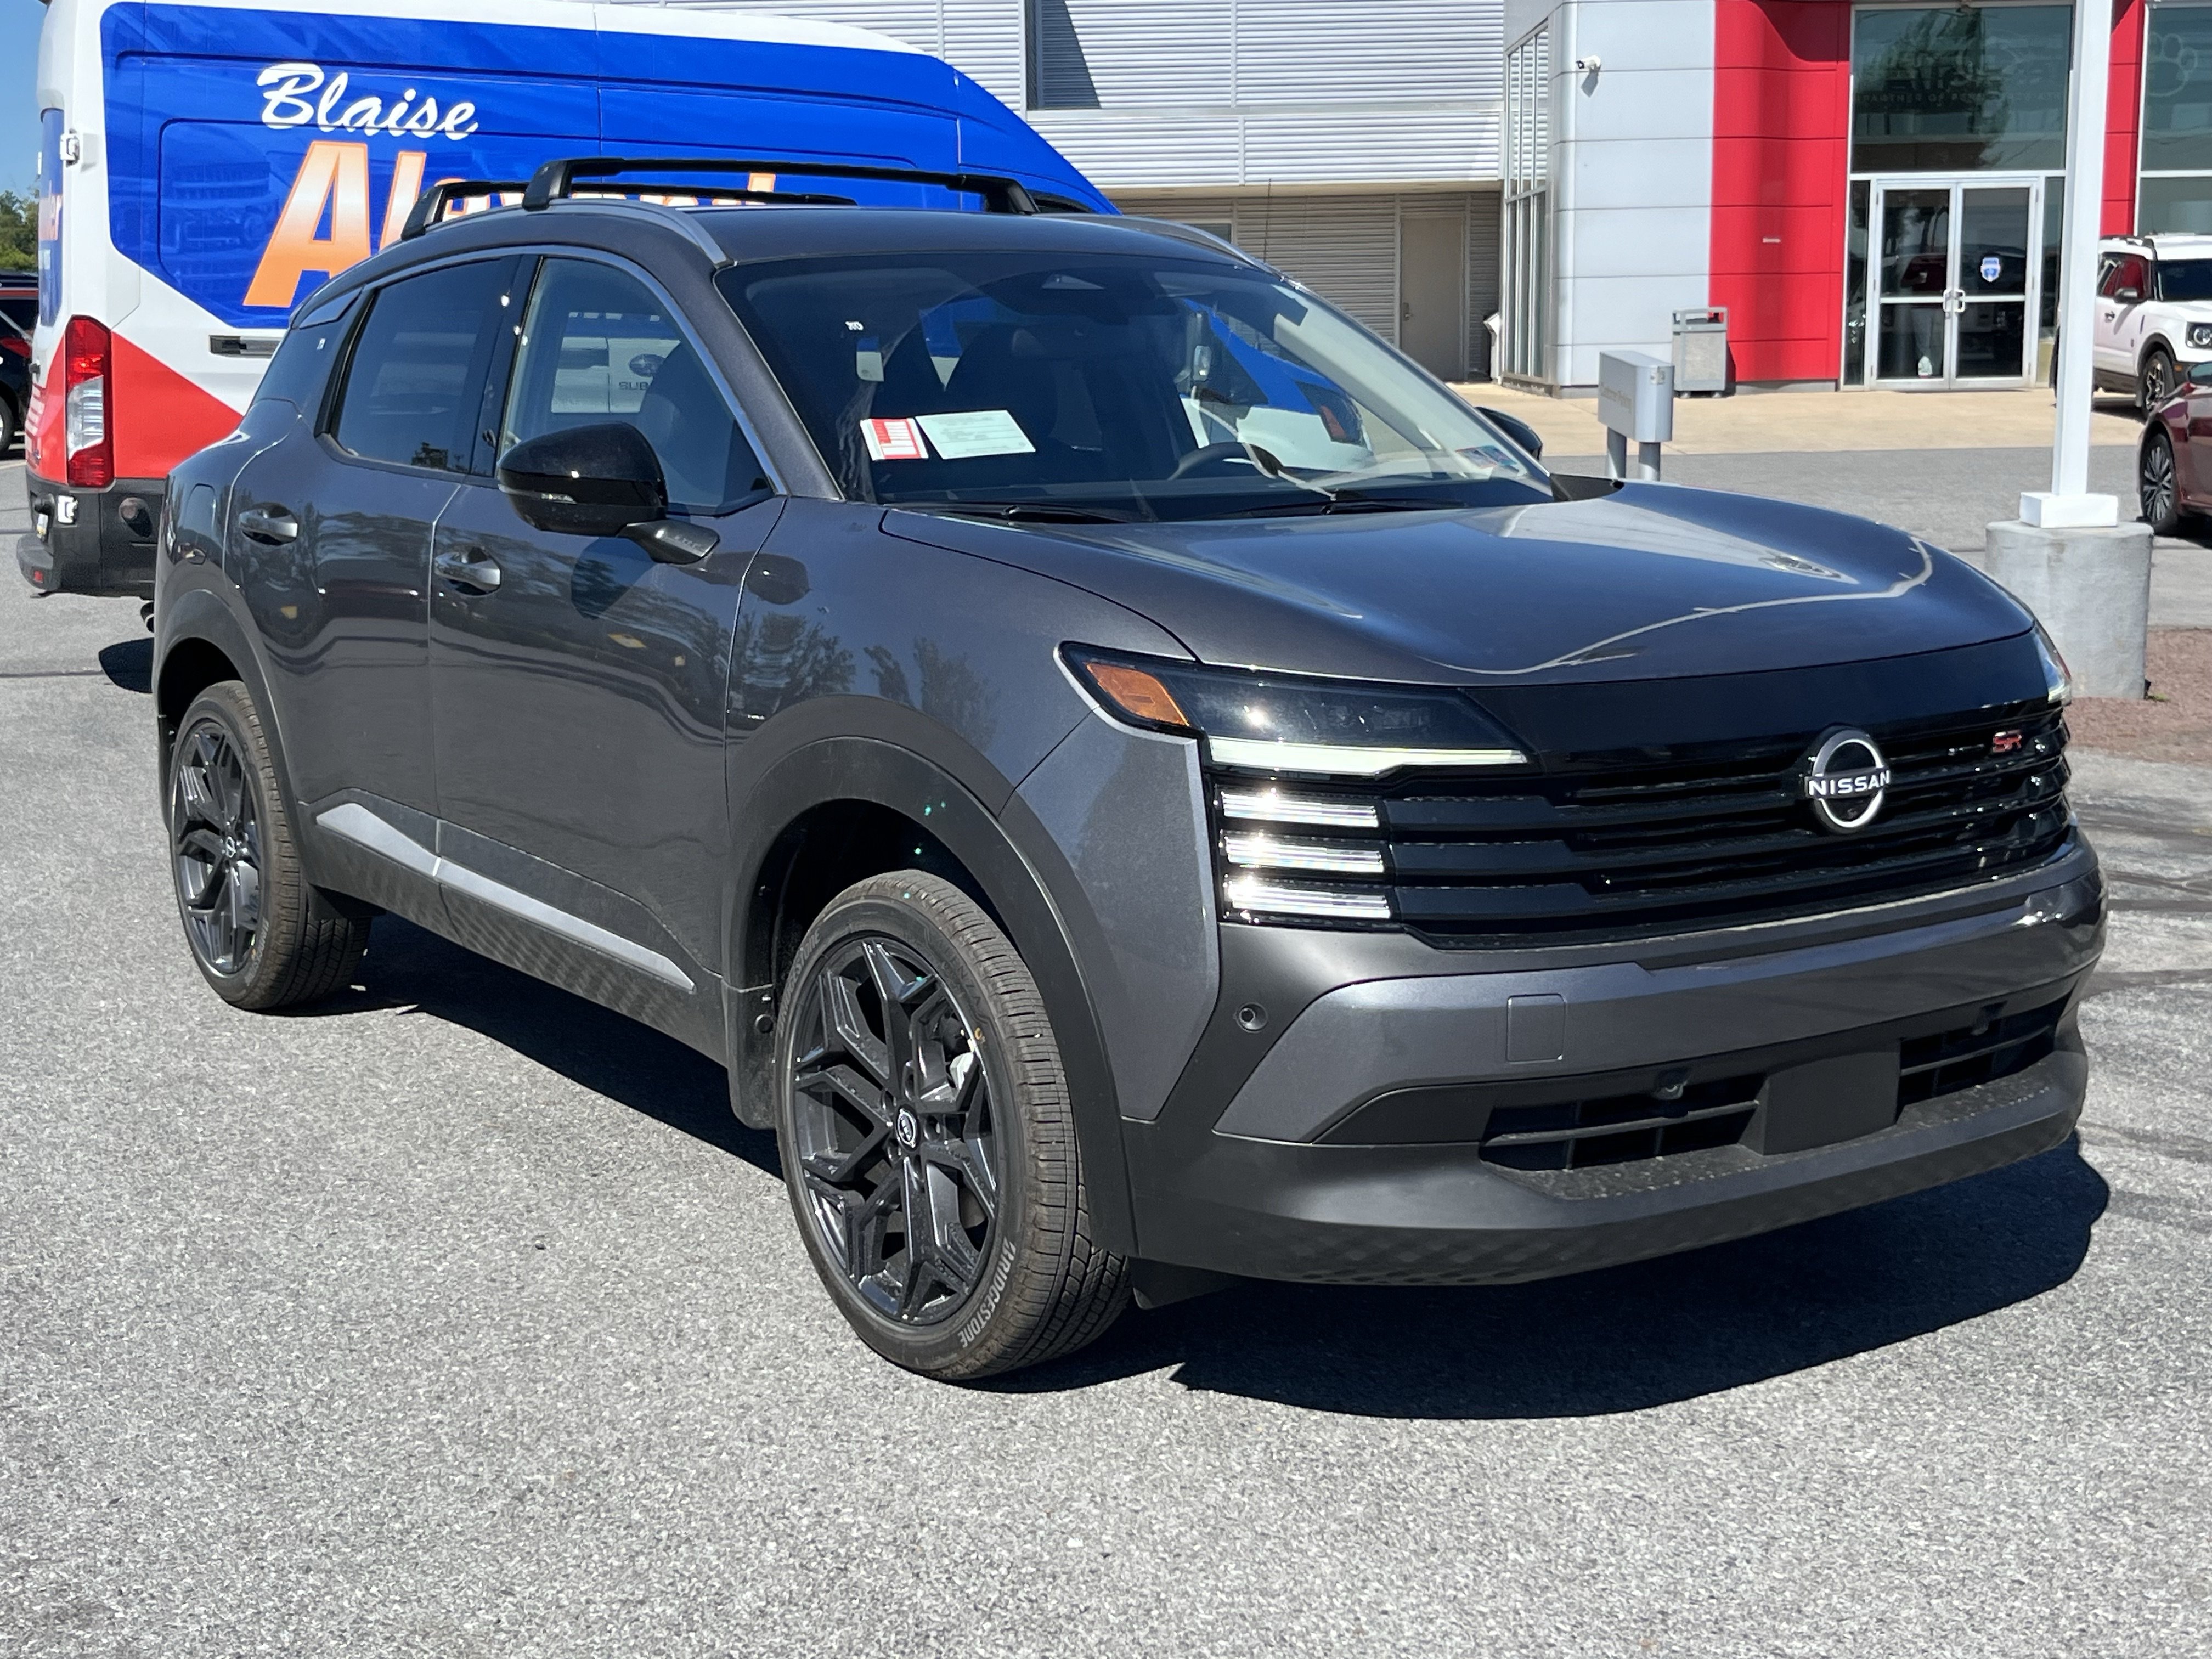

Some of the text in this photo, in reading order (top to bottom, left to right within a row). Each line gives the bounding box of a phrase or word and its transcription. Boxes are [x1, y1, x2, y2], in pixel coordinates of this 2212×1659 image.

[257, 63, 479, 140] Blaise
[619, 382, 649, 390] SUB
[1993, 730, 2023, 753] SR
[1809, 770, 1891, 796] NISSAN
[957, 1235, 1016, 1348] BRIDGESTONE
